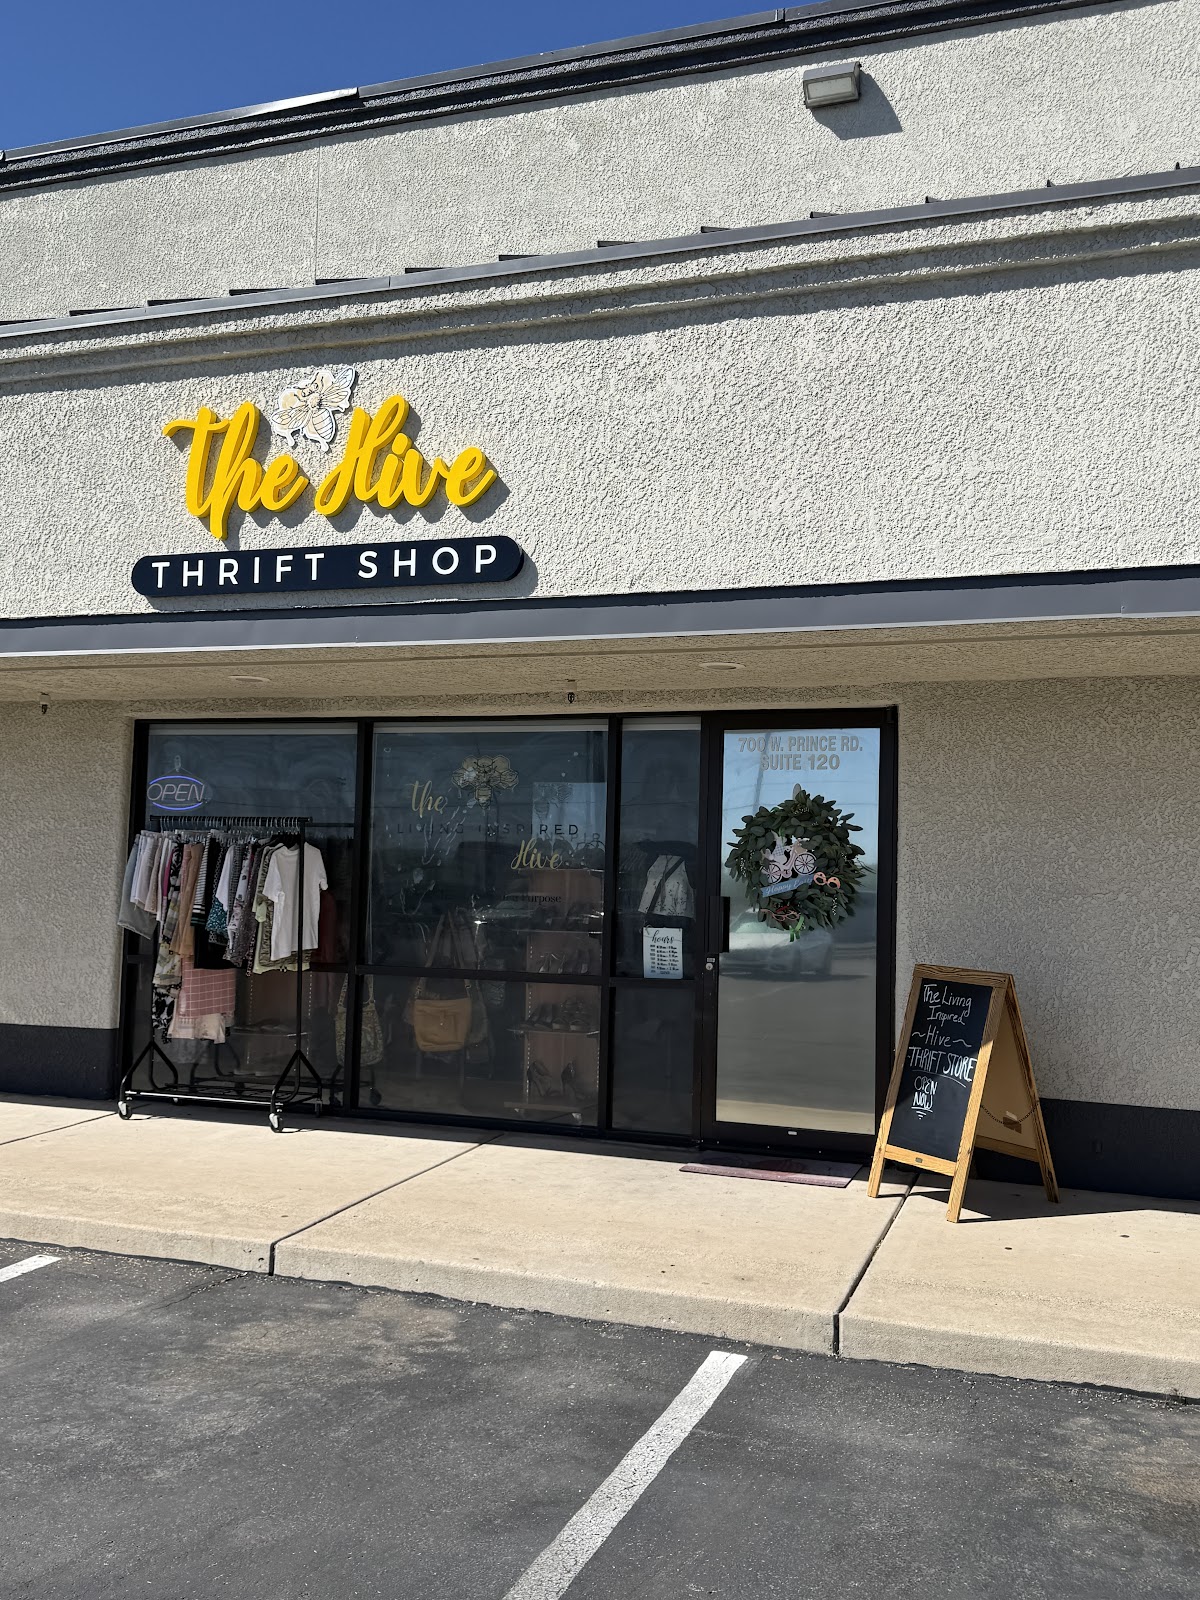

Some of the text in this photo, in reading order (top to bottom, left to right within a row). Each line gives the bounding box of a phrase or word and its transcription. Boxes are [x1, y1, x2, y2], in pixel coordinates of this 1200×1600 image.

[314, 395, 497, 518] Hive
[151, 544, 498, 589] THRIFT SHOP
[738, 735, 863, 752] 700 W. PRINCE RD.
[761, 753, 840, 770] SUITE 120
[147, 783, 205, 802] OPEN
[478, 823, 579, 835] INSPIRED
[510, 838, 564, 870] Hive
[765, 883, 791, 895] Happy
[651, 929, 675, 944] hours
[923, 984, 972, 1018] The Living
[908, 1046, 978, 1082] THRIFT STORE
[914, 1075, 937, 1096] OPEN
[912, 1092, 934, 1110] NOW
